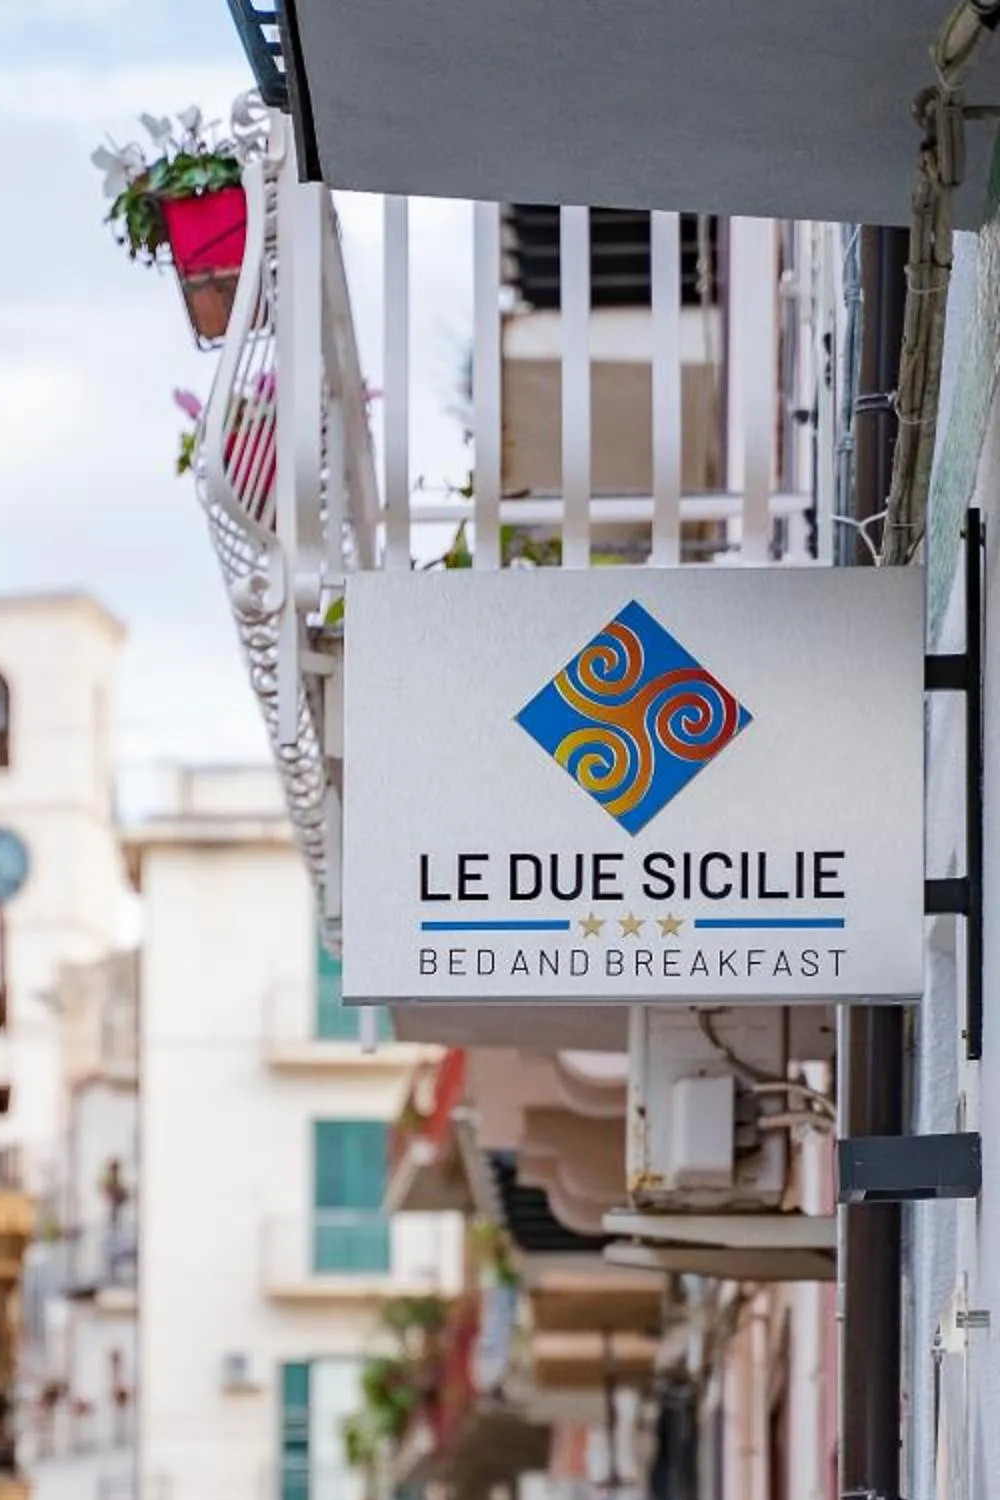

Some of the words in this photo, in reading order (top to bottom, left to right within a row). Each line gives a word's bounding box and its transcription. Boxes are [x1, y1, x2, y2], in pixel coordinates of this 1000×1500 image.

[420, 853, 489, 902] LE
[509, 853, 624, 901] DUE
[642, 850, 845, 901] SICILIE
[419, 948, 496, 976] BED
[510, 949, 589, 977] AND
[605, 949, 847, 977] BREAKFAST
